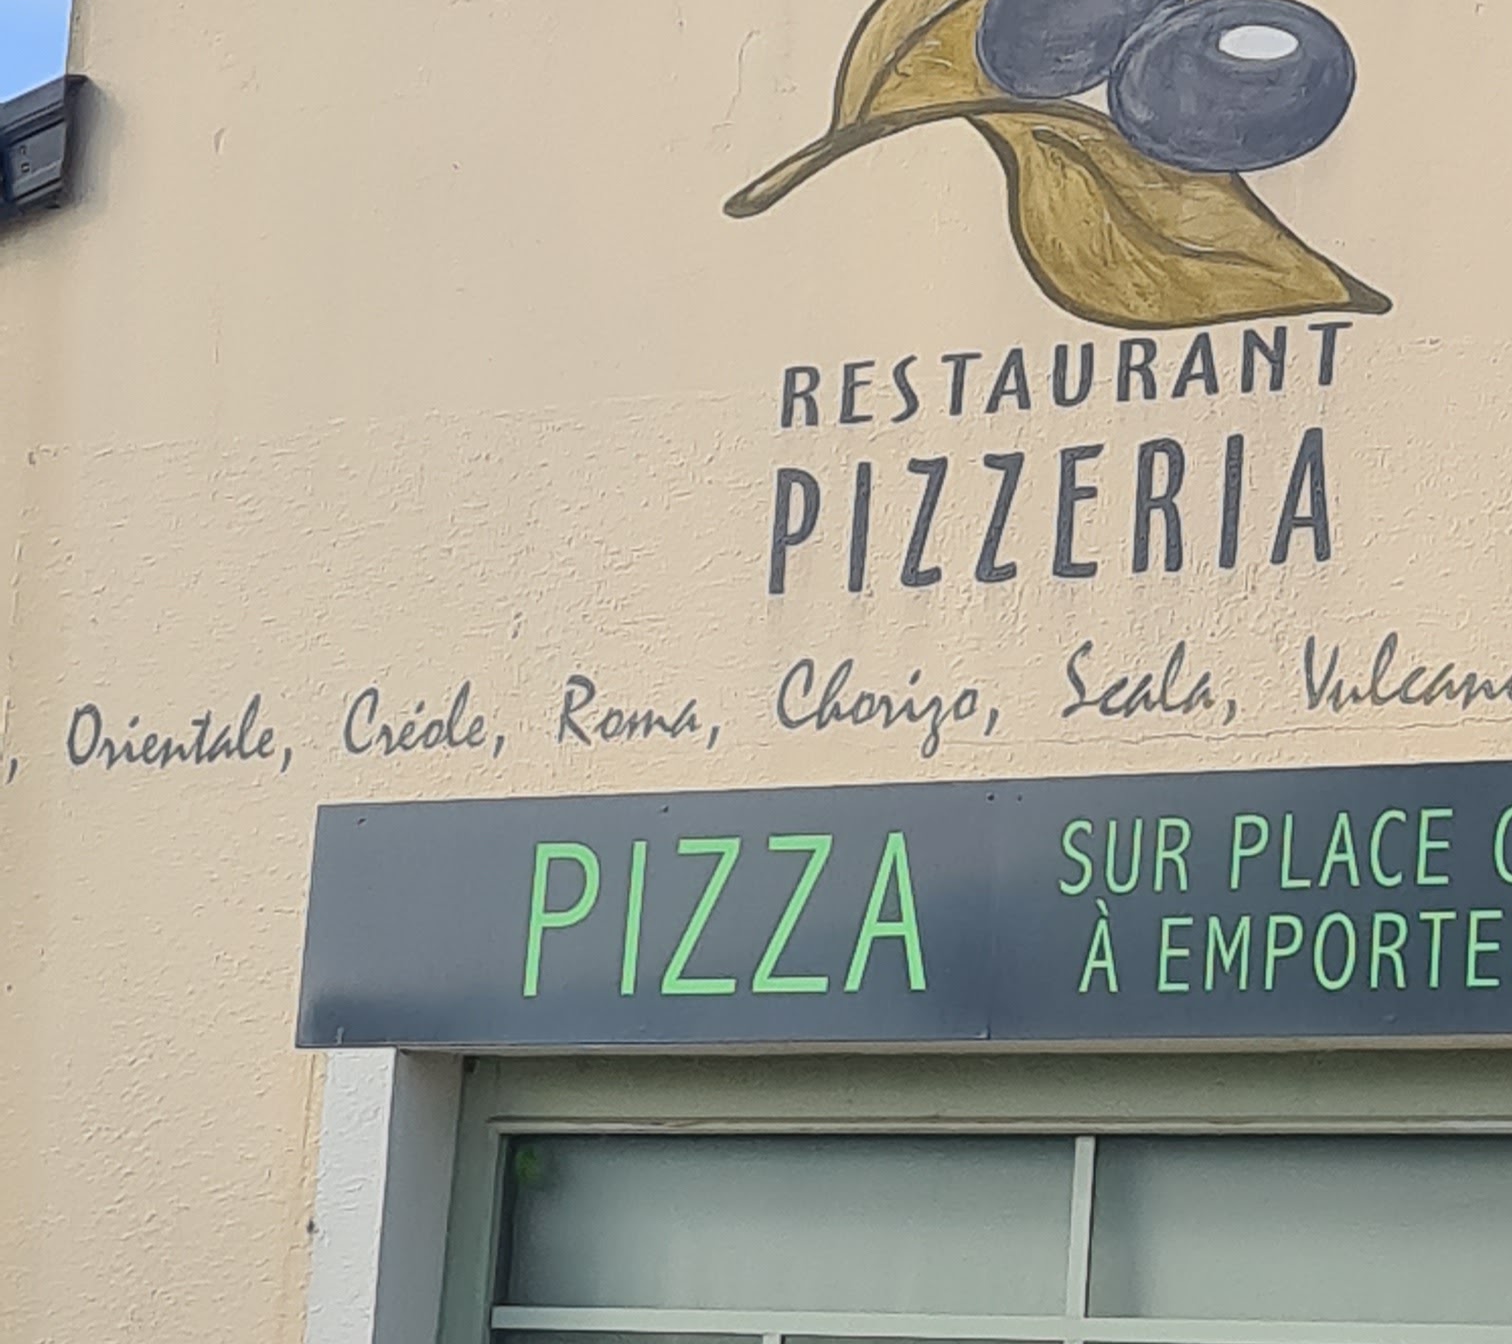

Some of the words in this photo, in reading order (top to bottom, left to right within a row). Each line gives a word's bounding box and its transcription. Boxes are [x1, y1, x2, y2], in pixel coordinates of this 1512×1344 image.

[780, 320, 1354, 428] RESTAURANT
[767, 425, 1333, 595] PIZZERIA
[66, 693, 294, 774] Orientale,
[343, 680, 506, 758] Créole,
[557, 673, 722, 750] Roma,
[775, 657, 1000, 759] Chorizo,
[1060, 639, 1239, 725] Scala,
[1057, 816, 1191, 896] SUR
[1229, 806, 1455, 891] PLACE
[522, 830, 928, 998] PIZZA
[1078, 897, 1119, 994] À
